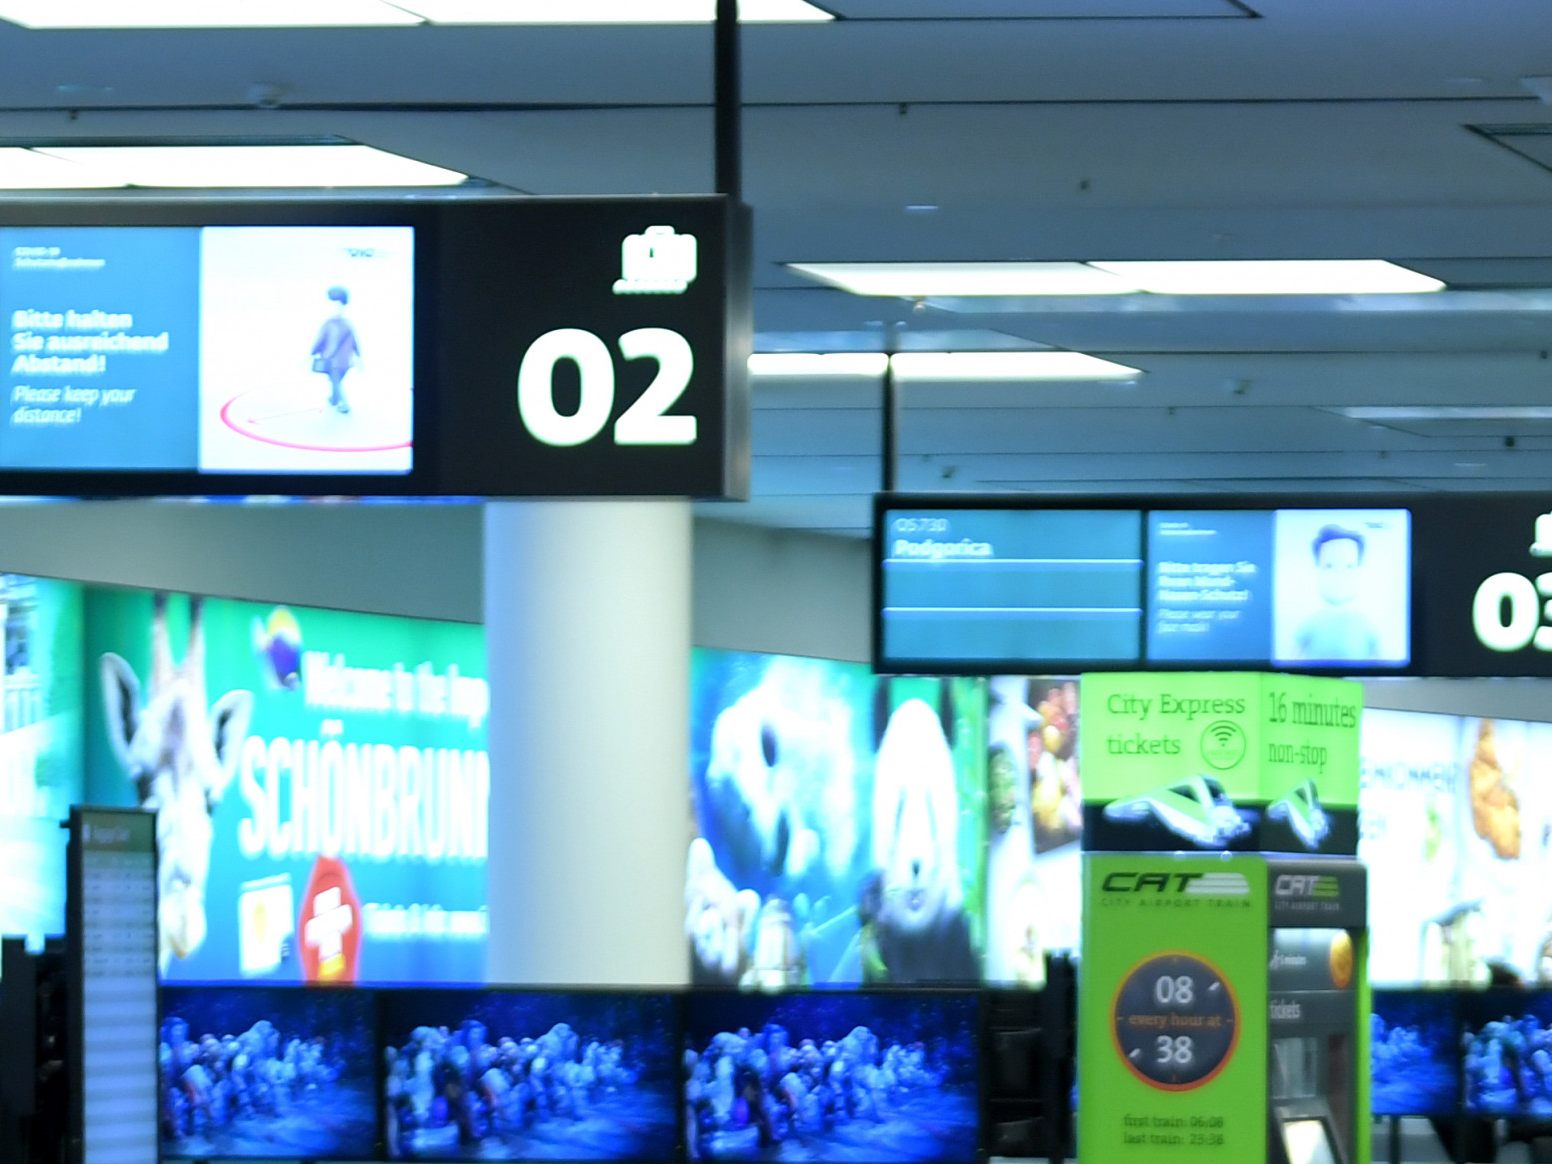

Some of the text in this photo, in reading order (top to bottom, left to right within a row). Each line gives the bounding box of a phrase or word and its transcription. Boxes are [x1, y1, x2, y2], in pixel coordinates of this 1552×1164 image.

[518, 327, 698, 446] 02
[1107, 693, 1245, 721] City Express
[1269, 692, 1356, 728] 16 minutes
[1107, 733, 1182, 755] tickets
[1269, 743, 1327, 774] non-stop
[1102, 872, 1204, 893] CAT
[1156, 975, 1194, 1004] 08
[1156, 1035, 1193, 1064] 38
